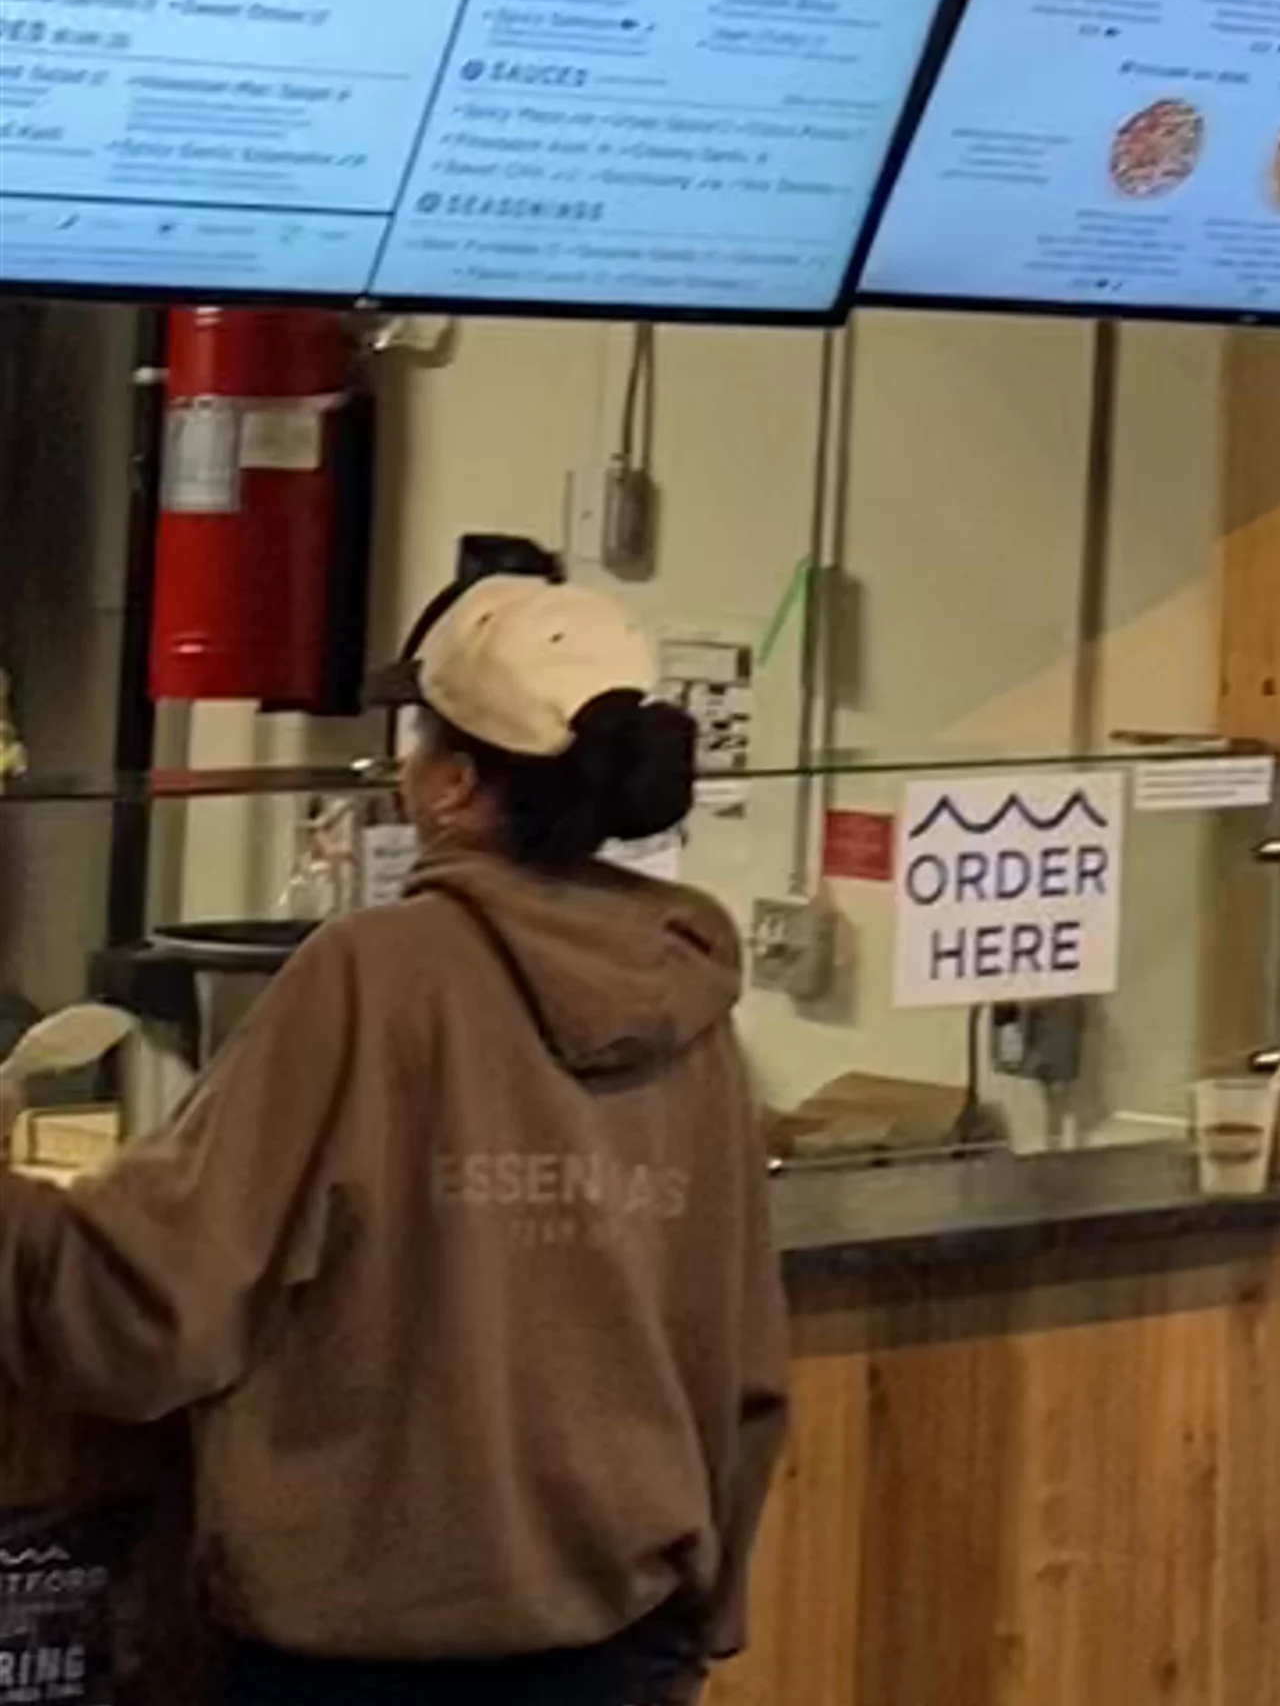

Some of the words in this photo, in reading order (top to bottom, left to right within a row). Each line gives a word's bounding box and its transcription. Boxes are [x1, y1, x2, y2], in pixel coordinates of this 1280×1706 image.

[487, 59, 590, 88] SAUCES
[444, 192, 607, 223] SEASONINGS
[906, 845, 1108, 906] ORDER
[929, 921, 1081, 980] HERE
